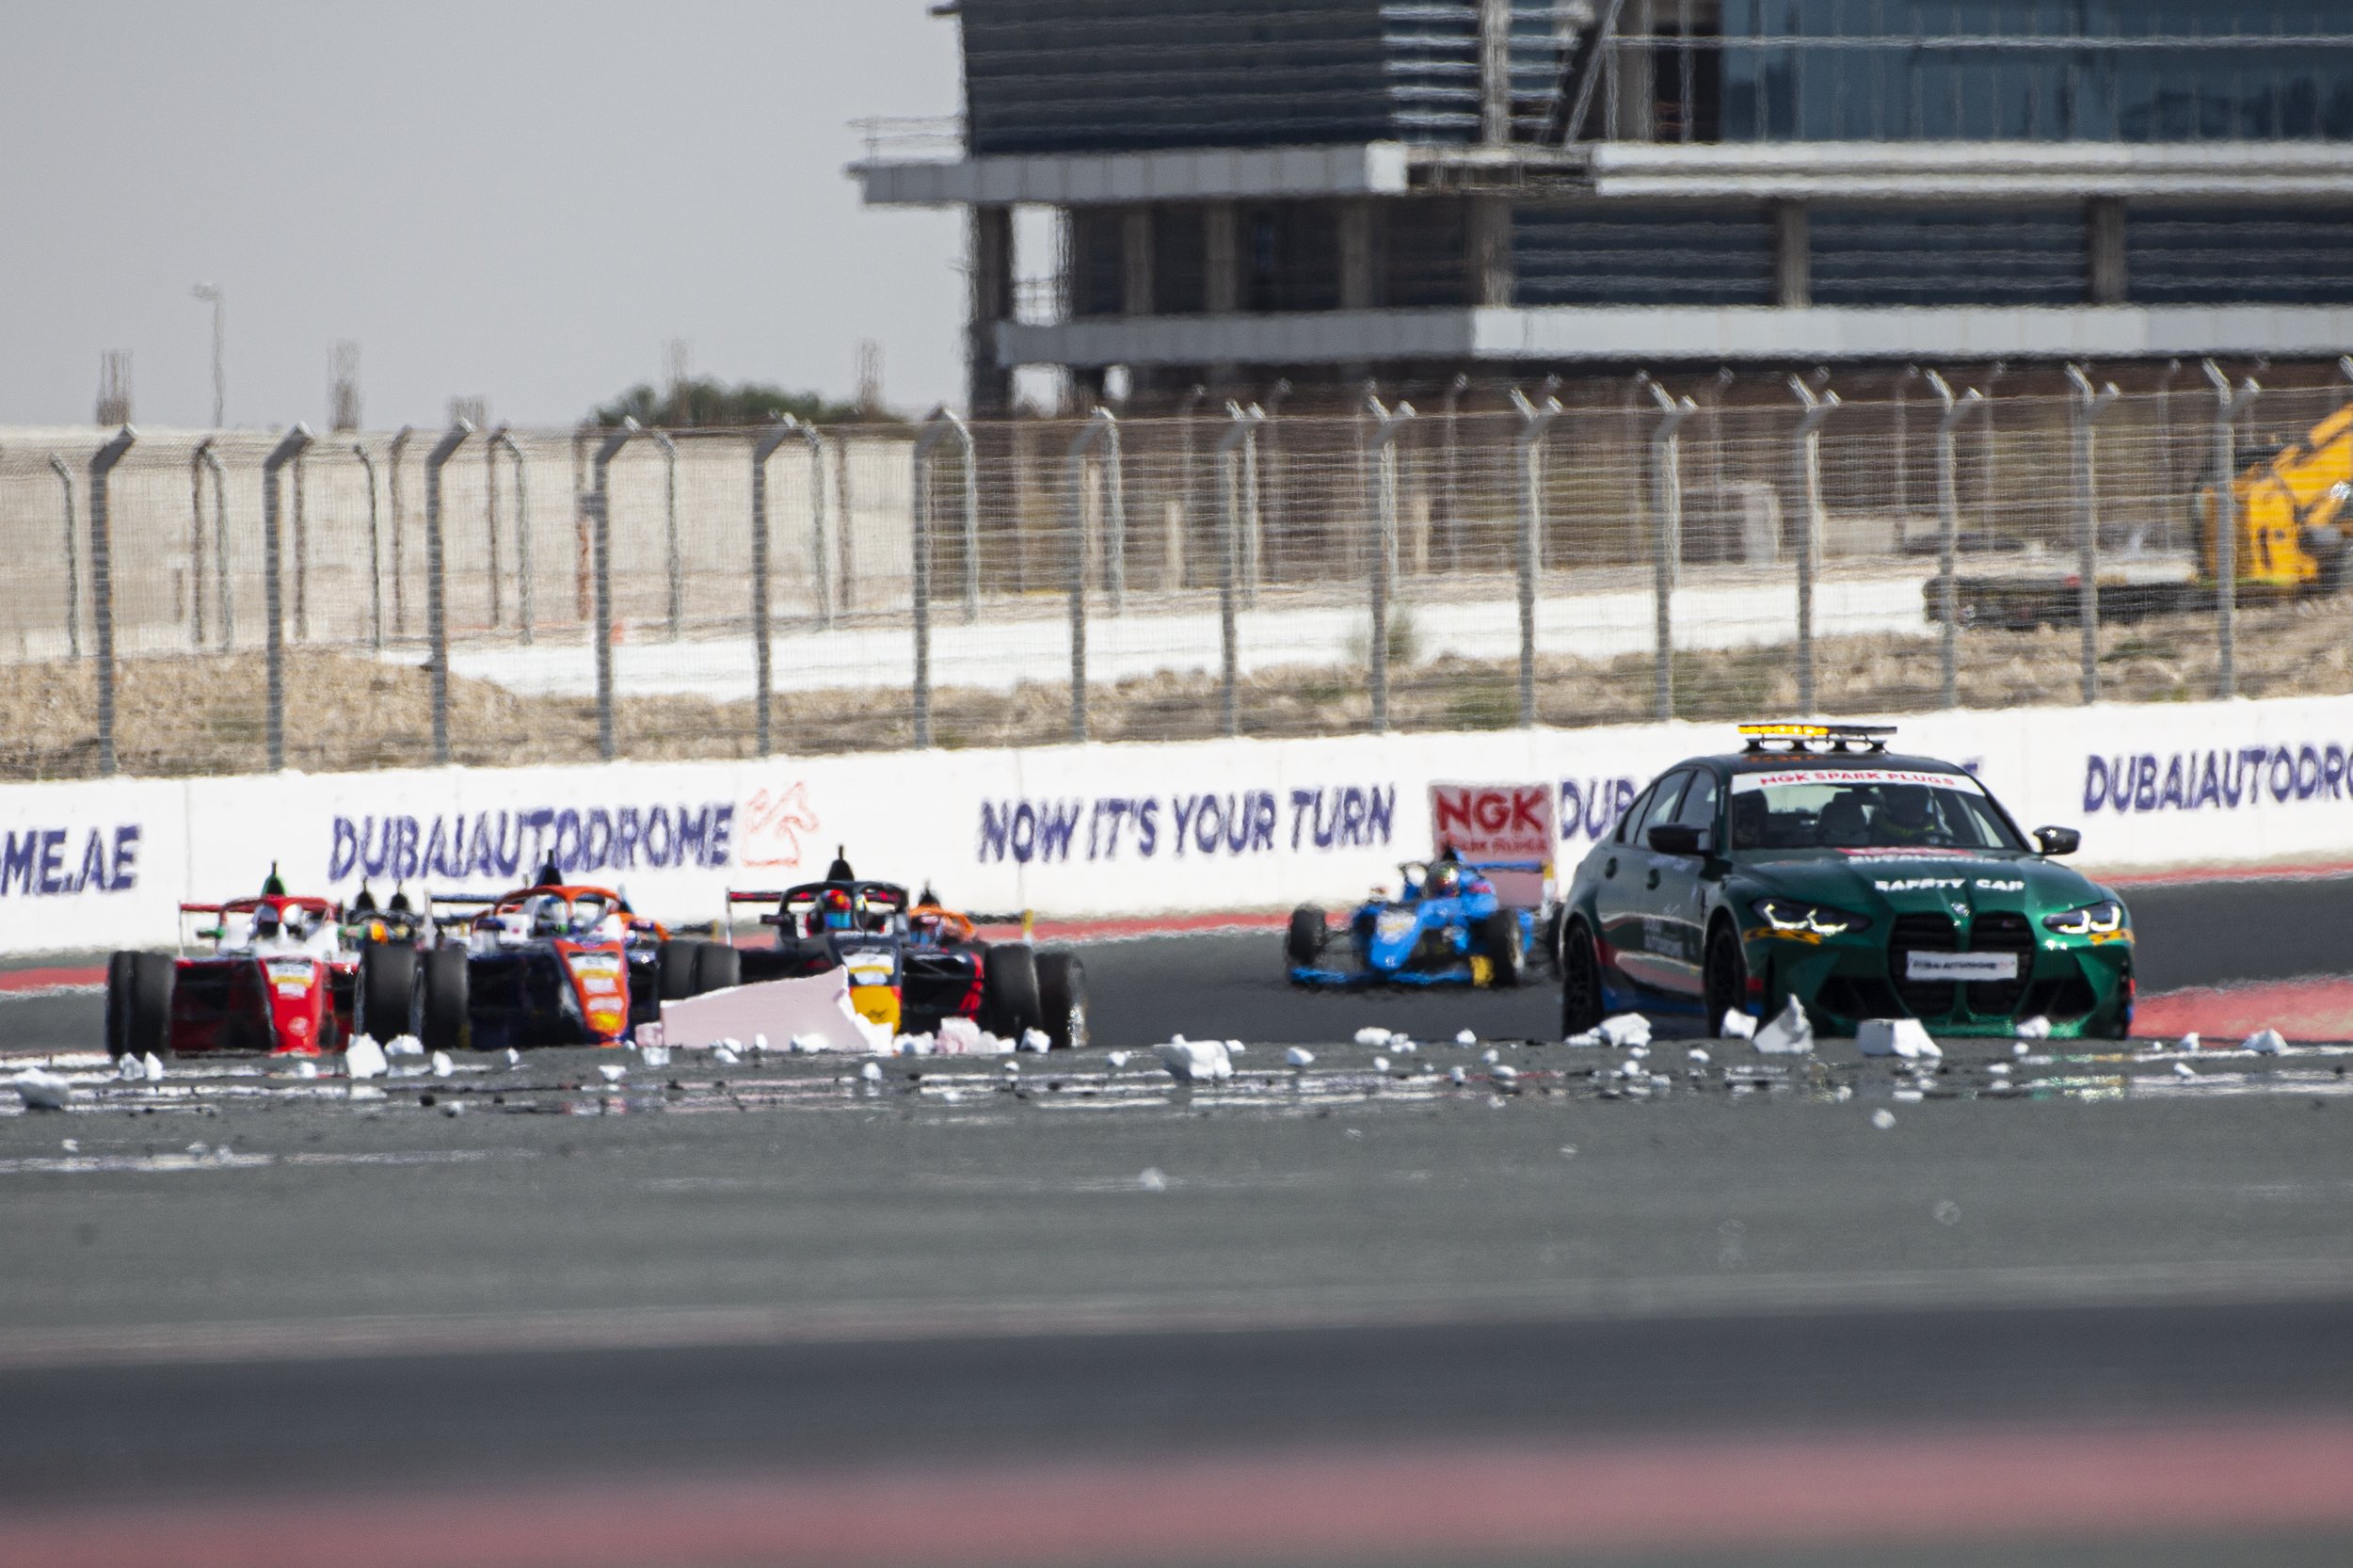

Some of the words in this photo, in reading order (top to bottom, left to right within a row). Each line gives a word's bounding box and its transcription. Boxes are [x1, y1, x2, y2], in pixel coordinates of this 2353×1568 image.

[1760, 773, 1810, 786] NGK
[1815, 772, 1881, 781] SPARK
[1888, 773, 1956, 786] PLUGS
[979, 796, 1082, 864] NOW
[1087, 796, 1160, 860] IT'S
[1173, 789, 1277, 856] YOUR
[1289, 783, 1396, 851] TURN
[1436, 791, 1545, 834] NGK
[1875, 877, 1966, 891] SAFETY
[1976, 878, 2025, 891] CAR
